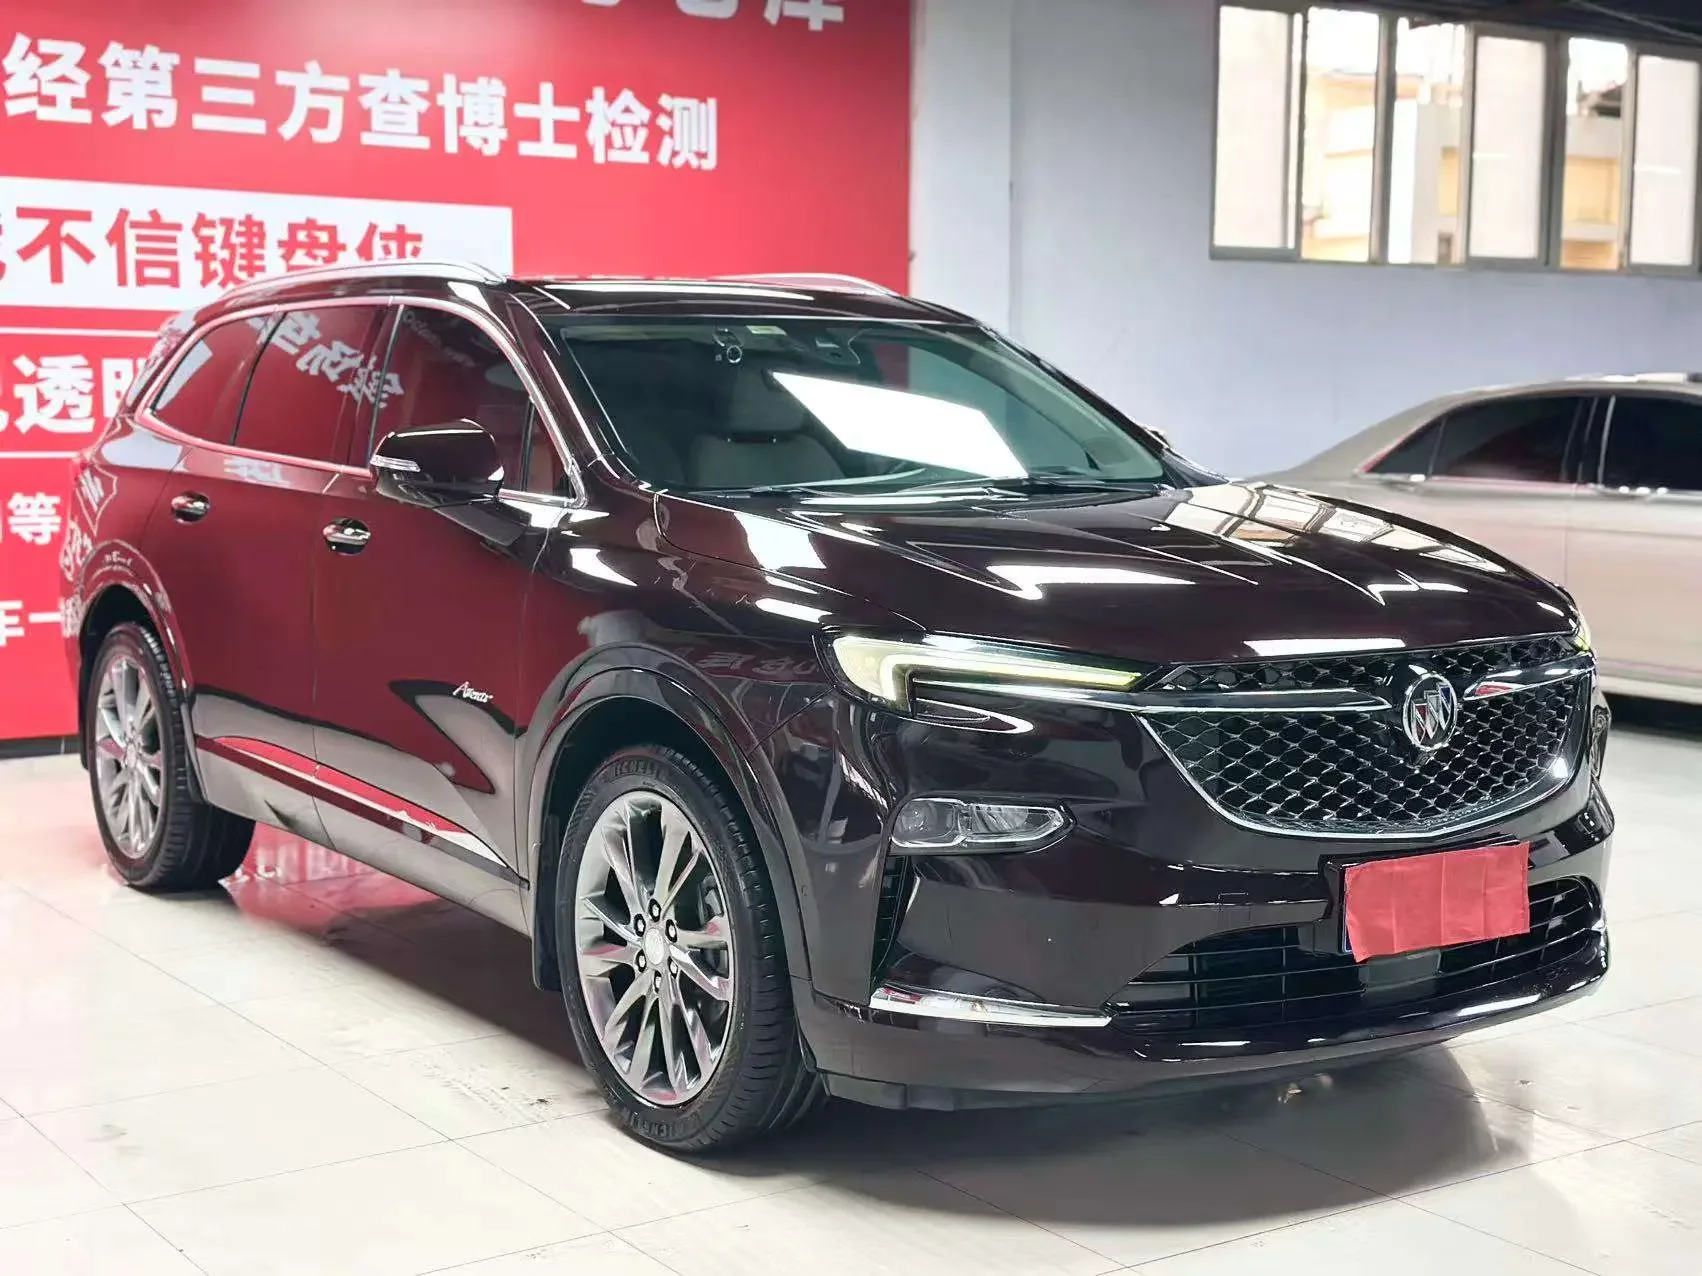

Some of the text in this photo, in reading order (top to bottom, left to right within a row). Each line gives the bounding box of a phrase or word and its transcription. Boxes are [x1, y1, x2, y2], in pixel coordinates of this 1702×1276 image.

[2, 33, 718, 171] 经第三方查博士检测
[0, 206, 424, 289] 不信键盘侠
[0, 492, 61, 545] 等
